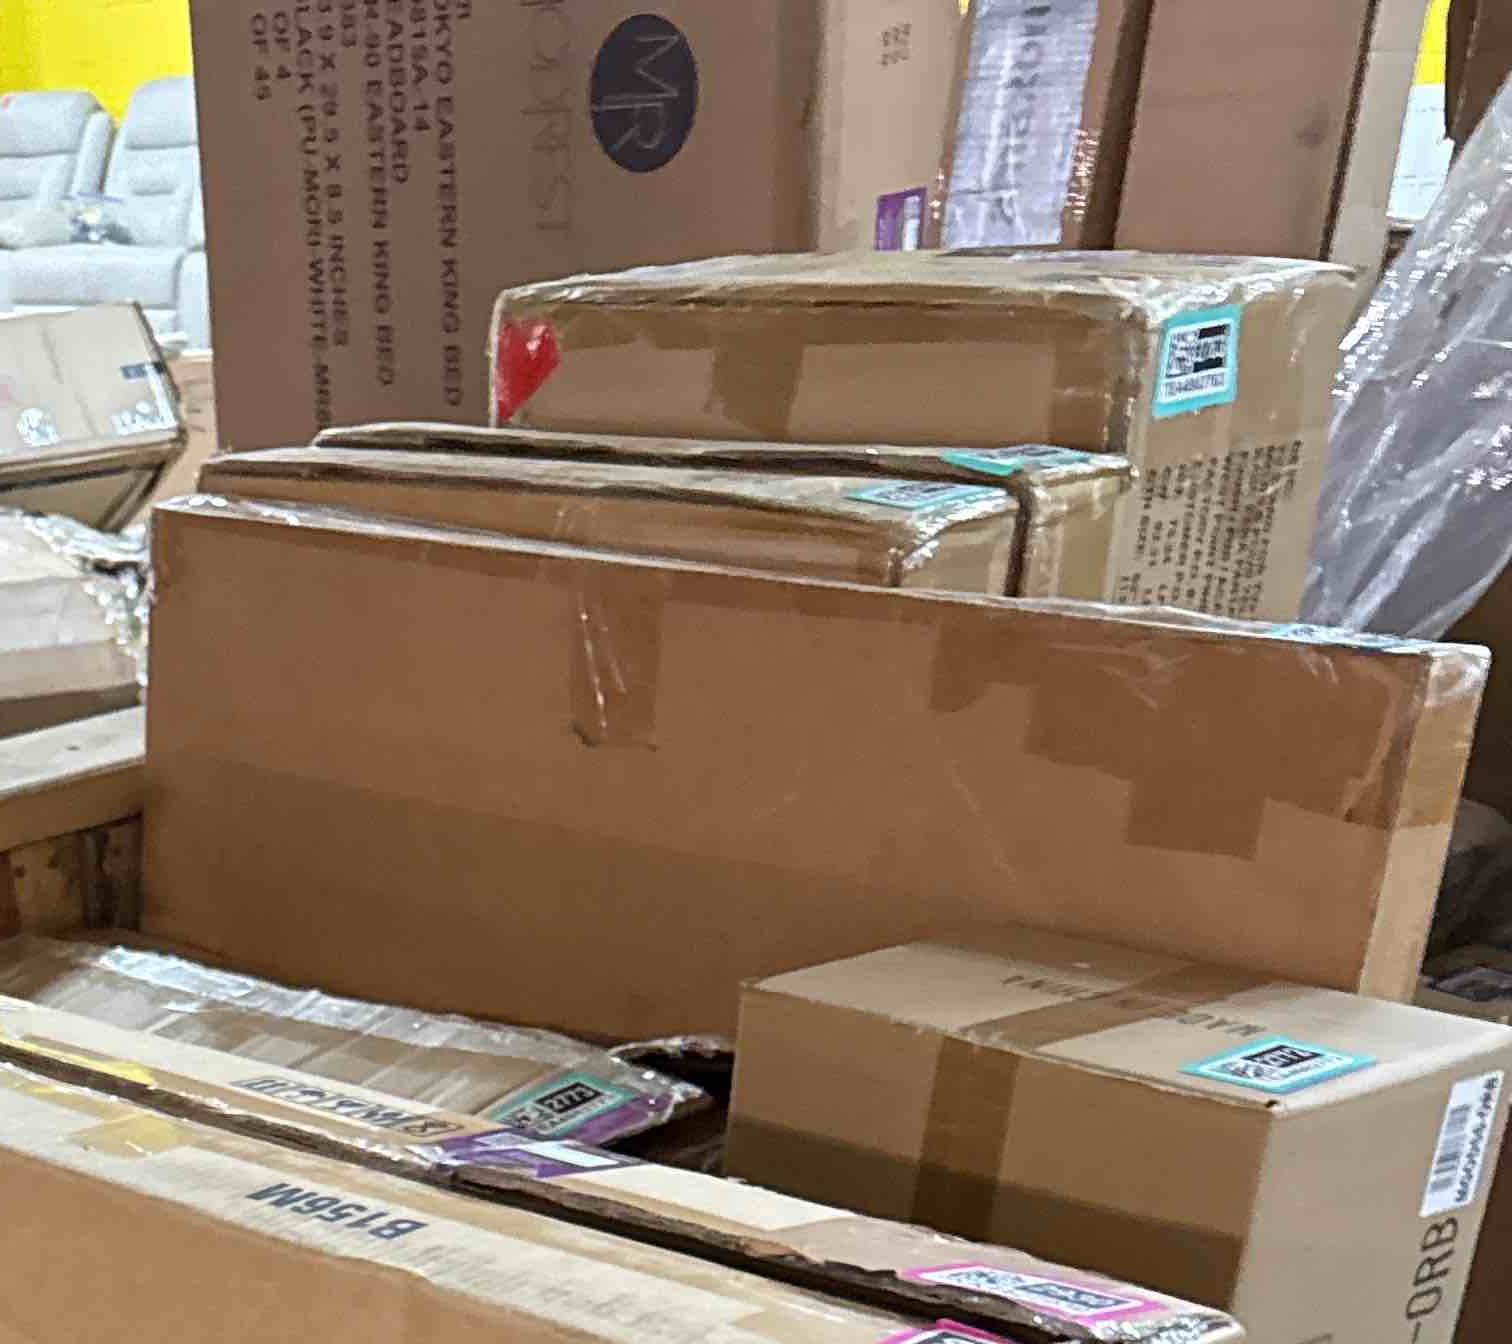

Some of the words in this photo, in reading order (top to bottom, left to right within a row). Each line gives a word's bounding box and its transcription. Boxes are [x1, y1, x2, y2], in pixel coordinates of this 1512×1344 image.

[366, 79, 392, 230] EASTERN
[436, 95, 461, 249] EASTERN
[372, 239, 394, 315] KING
[441, 257, 462, 335] KING
[442, 343, 464, 408] BED
[246, 1183, 428, 1241] B156M
